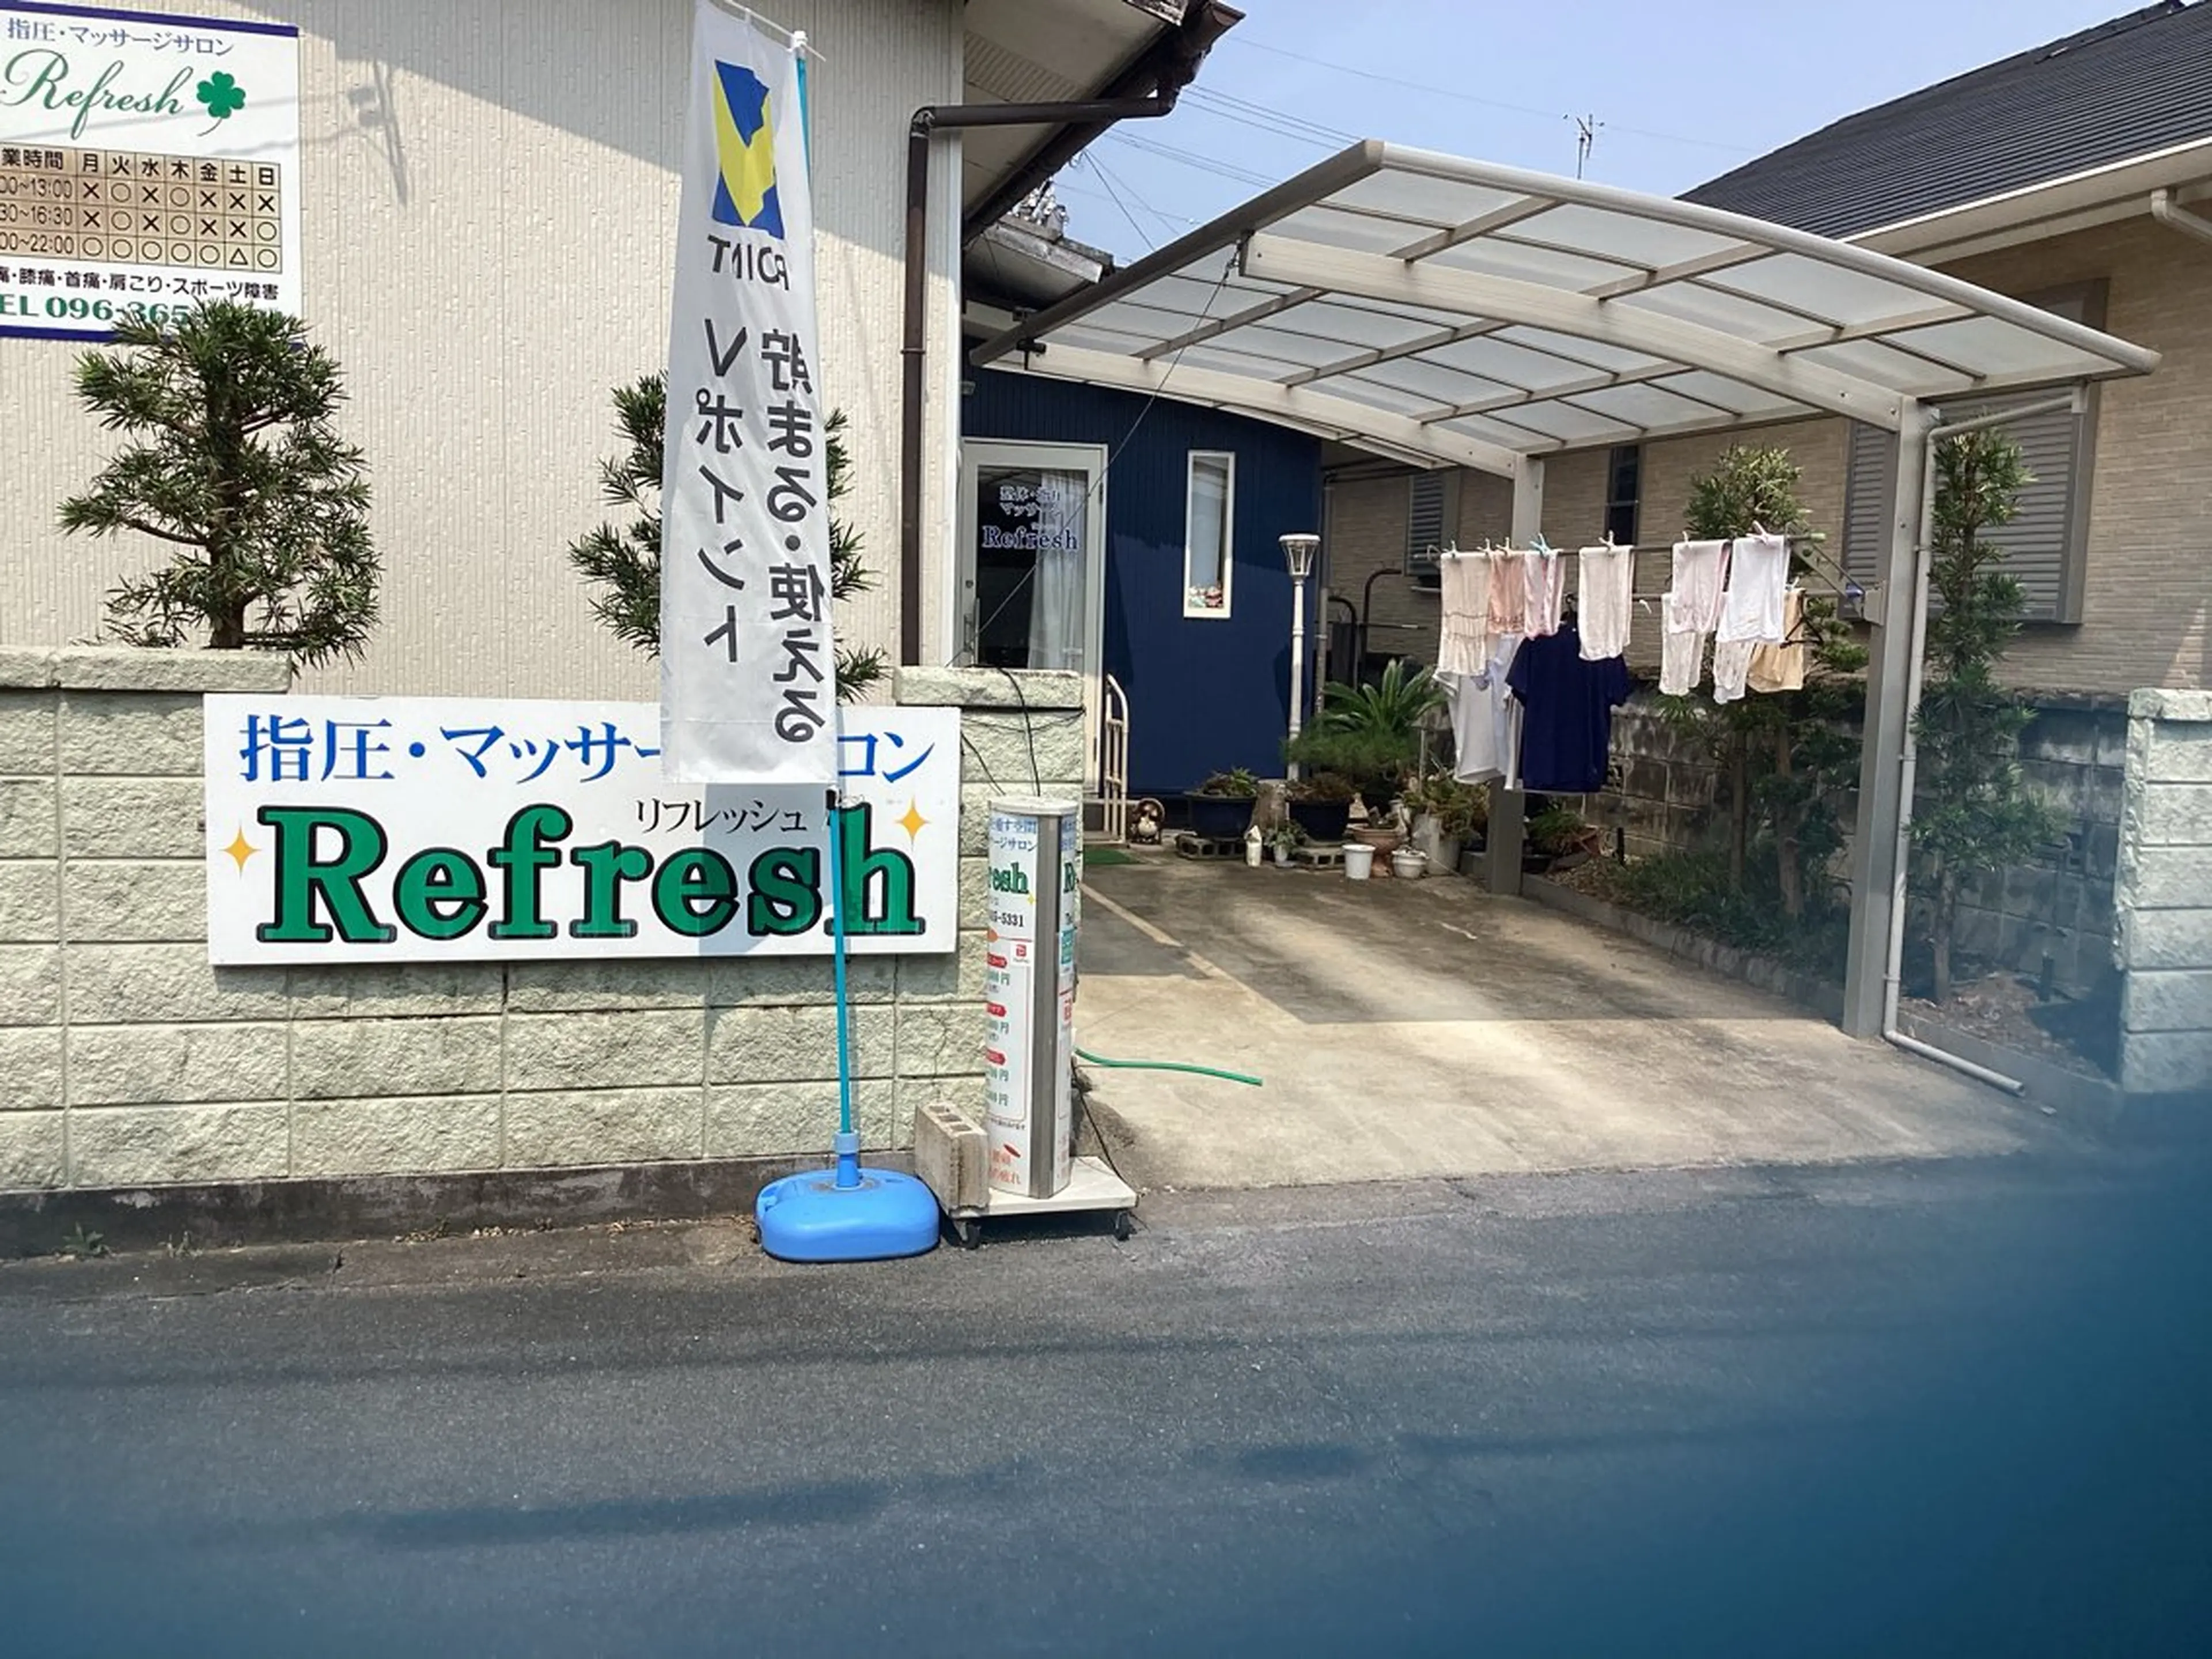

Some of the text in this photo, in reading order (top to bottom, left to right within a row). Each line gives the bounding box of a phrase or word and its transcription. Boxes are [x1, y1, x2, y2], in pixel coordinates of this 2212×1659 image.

[7, 17, 234, 56] 指圧・マッサージサロン
[0, 48, 194, 141] Refresh
[82, 153, 99, 173] 月
[112, 156, 131, 176] 火
[141, 157, 160, 177] 水
[171, 160, 190, 180] 木
[200, 162, 218, 182] 金
[229, 165, 247, 184] 土
[259, 167, 275, 186] 日
[45, 296, 190, 327] 096-365
[981, 525, 1080, 551] Refresh
[637, 797, 808, 834] リフレッシュ
[256, 802, 926, 944] Refresh
